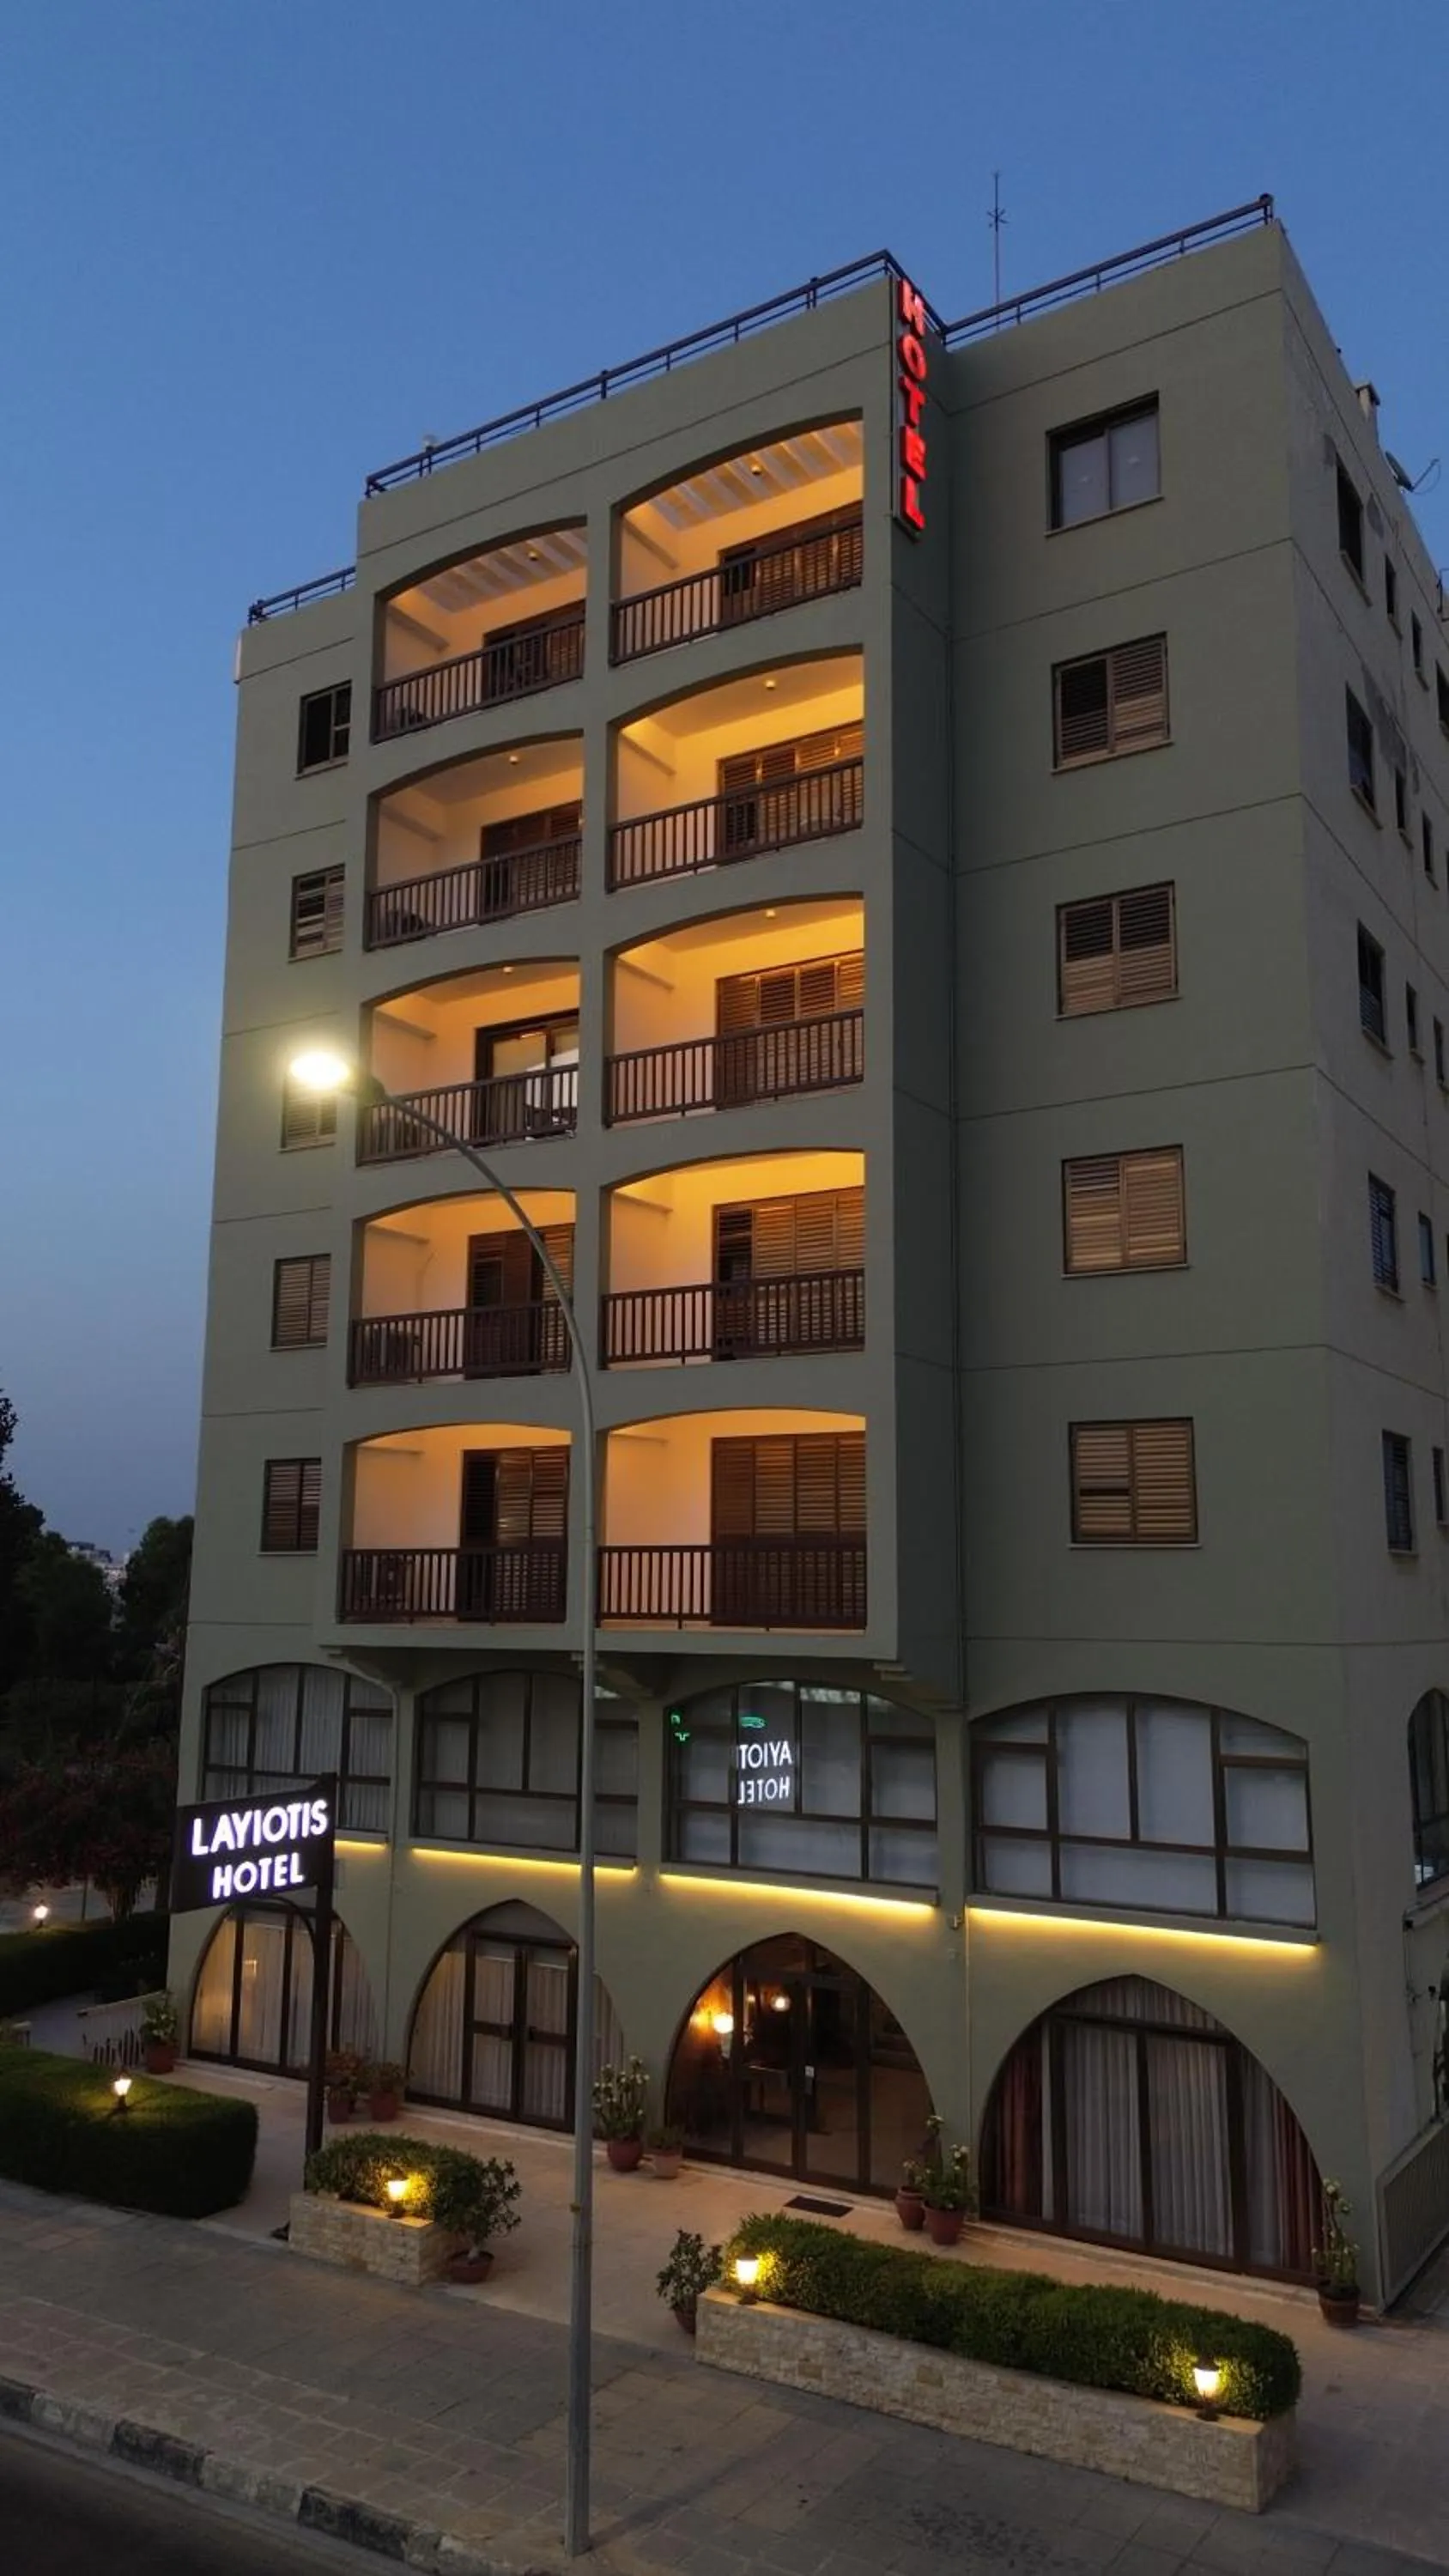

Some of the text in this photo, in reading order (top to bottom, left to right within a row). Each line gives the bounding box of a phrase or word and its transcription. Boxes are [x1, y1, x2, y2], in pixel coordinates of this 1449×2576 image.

[898, 278, 927, 531] HOTEL
[191, 1799, 329, 1856] LAYIOTIS
[212, 1852, 305, 1899] HOTEL
